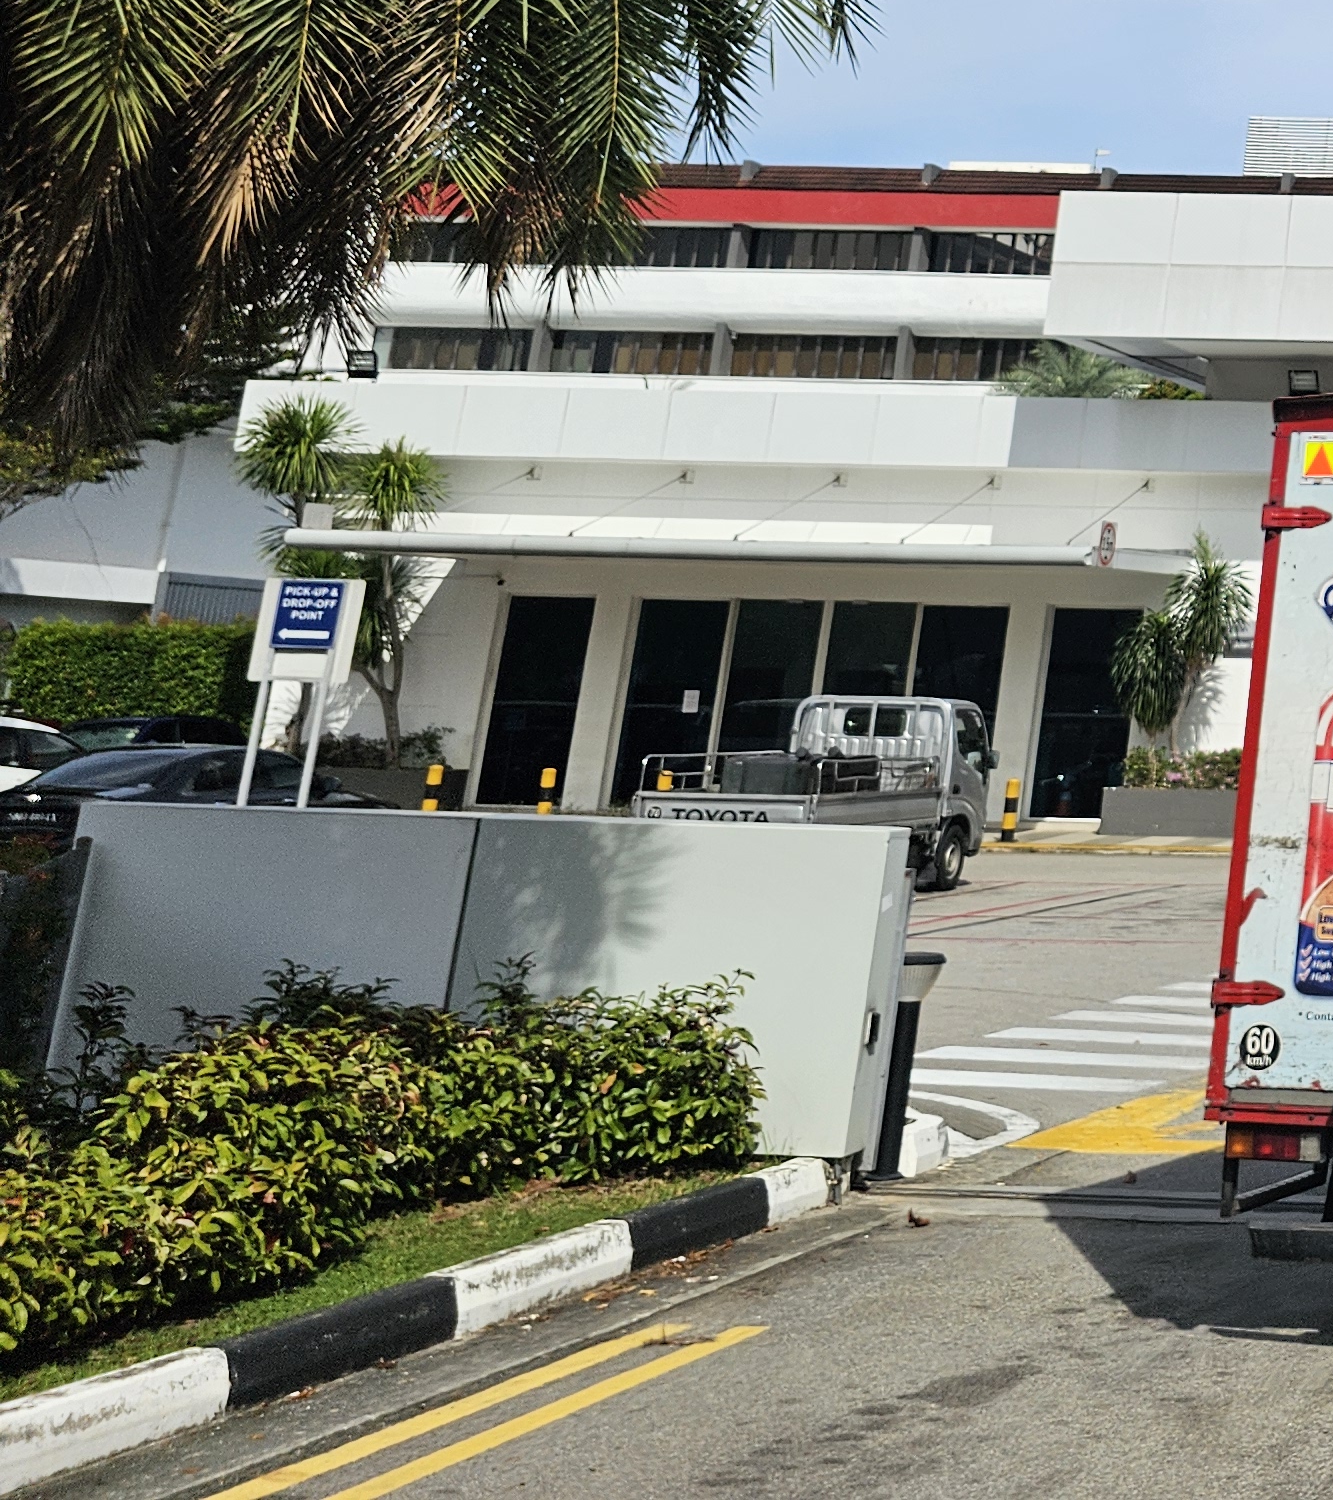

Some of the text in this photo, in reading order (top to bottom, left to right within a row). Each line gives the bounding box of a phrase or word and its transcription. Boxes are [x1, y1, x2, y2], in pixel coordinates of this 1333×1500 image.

[284, 585, 329, 597] PICK-UP
[282, 597, 338, 609] DROP-OFF
[289, 609, 324, 620] POINT
[671, 808, 769, 823] TOYOTA
[1246, 1026, 1275, 1055] 60
[1245, 1053, 1273, 1067] km/h
